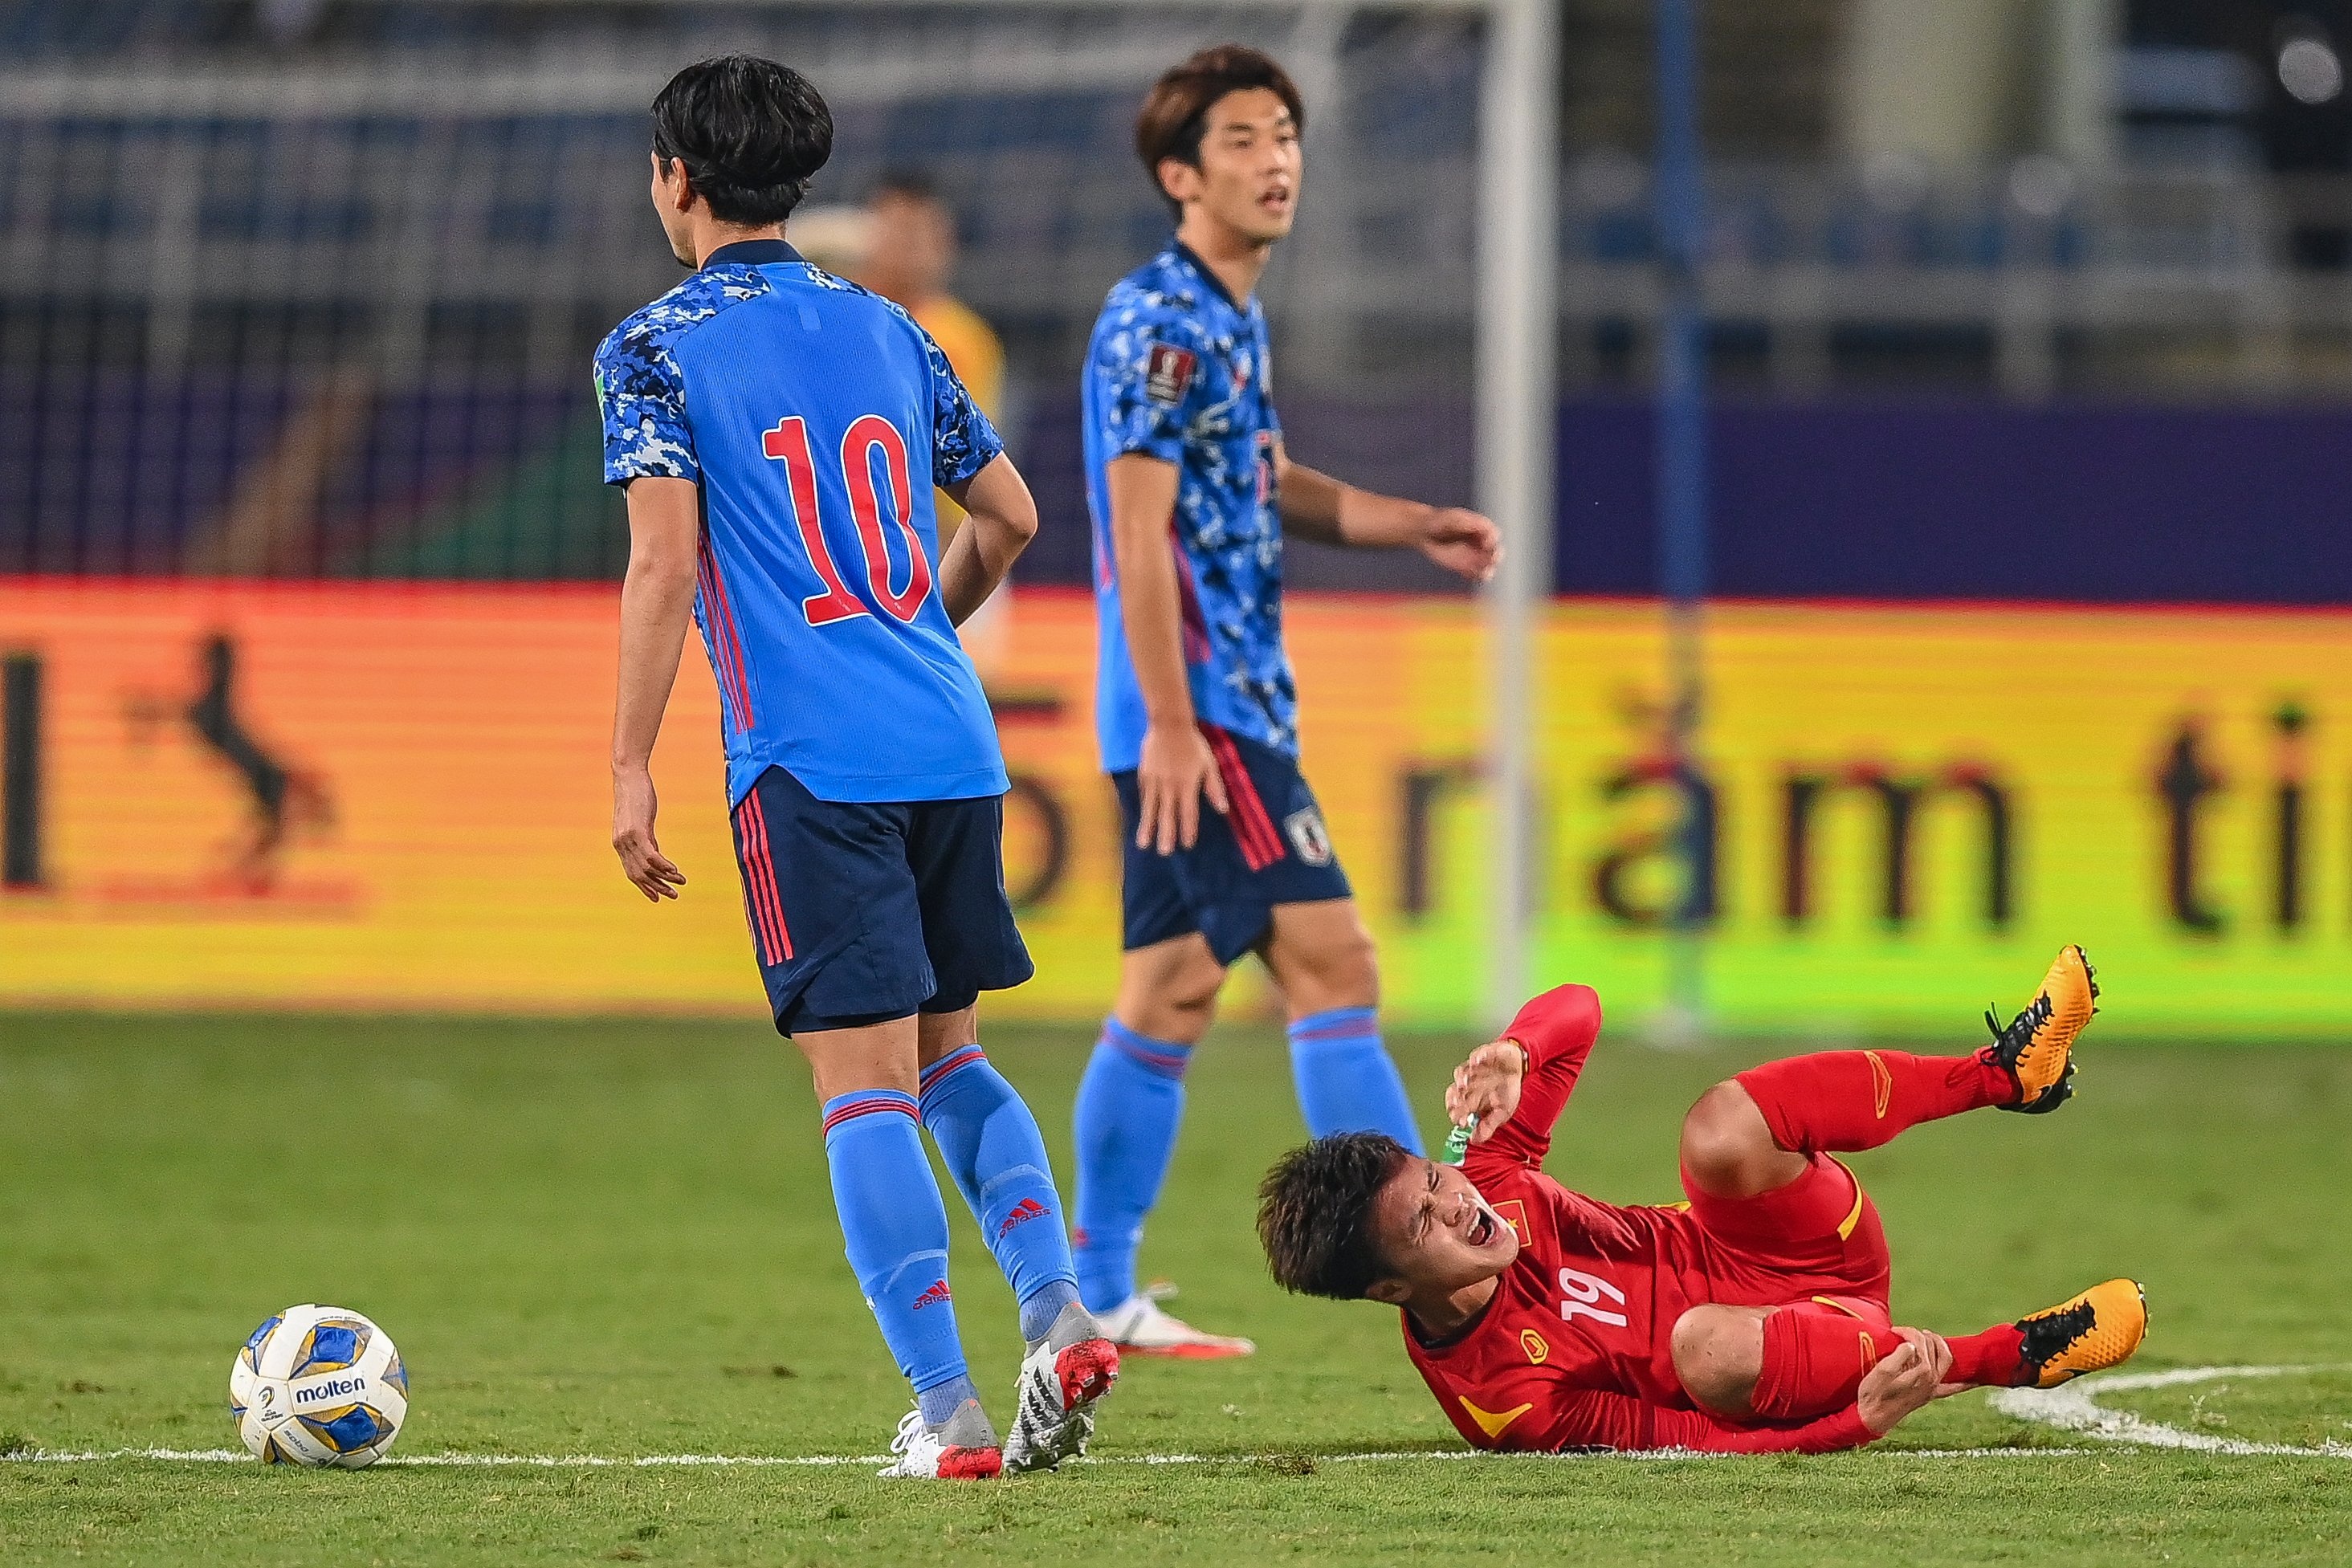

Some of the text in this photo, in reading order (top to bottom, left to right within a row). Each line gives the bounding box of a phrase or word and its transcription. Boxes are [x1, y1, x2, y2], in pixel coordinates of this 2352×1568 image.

[762, 413, 932, 628] 10
[2152, 697, 2352, 935] ti
[999, 1208, 1051, 1240] adidas
[1558, 1266, 1628, 1328] 19
[296, 1377, 365, 1403] molten
